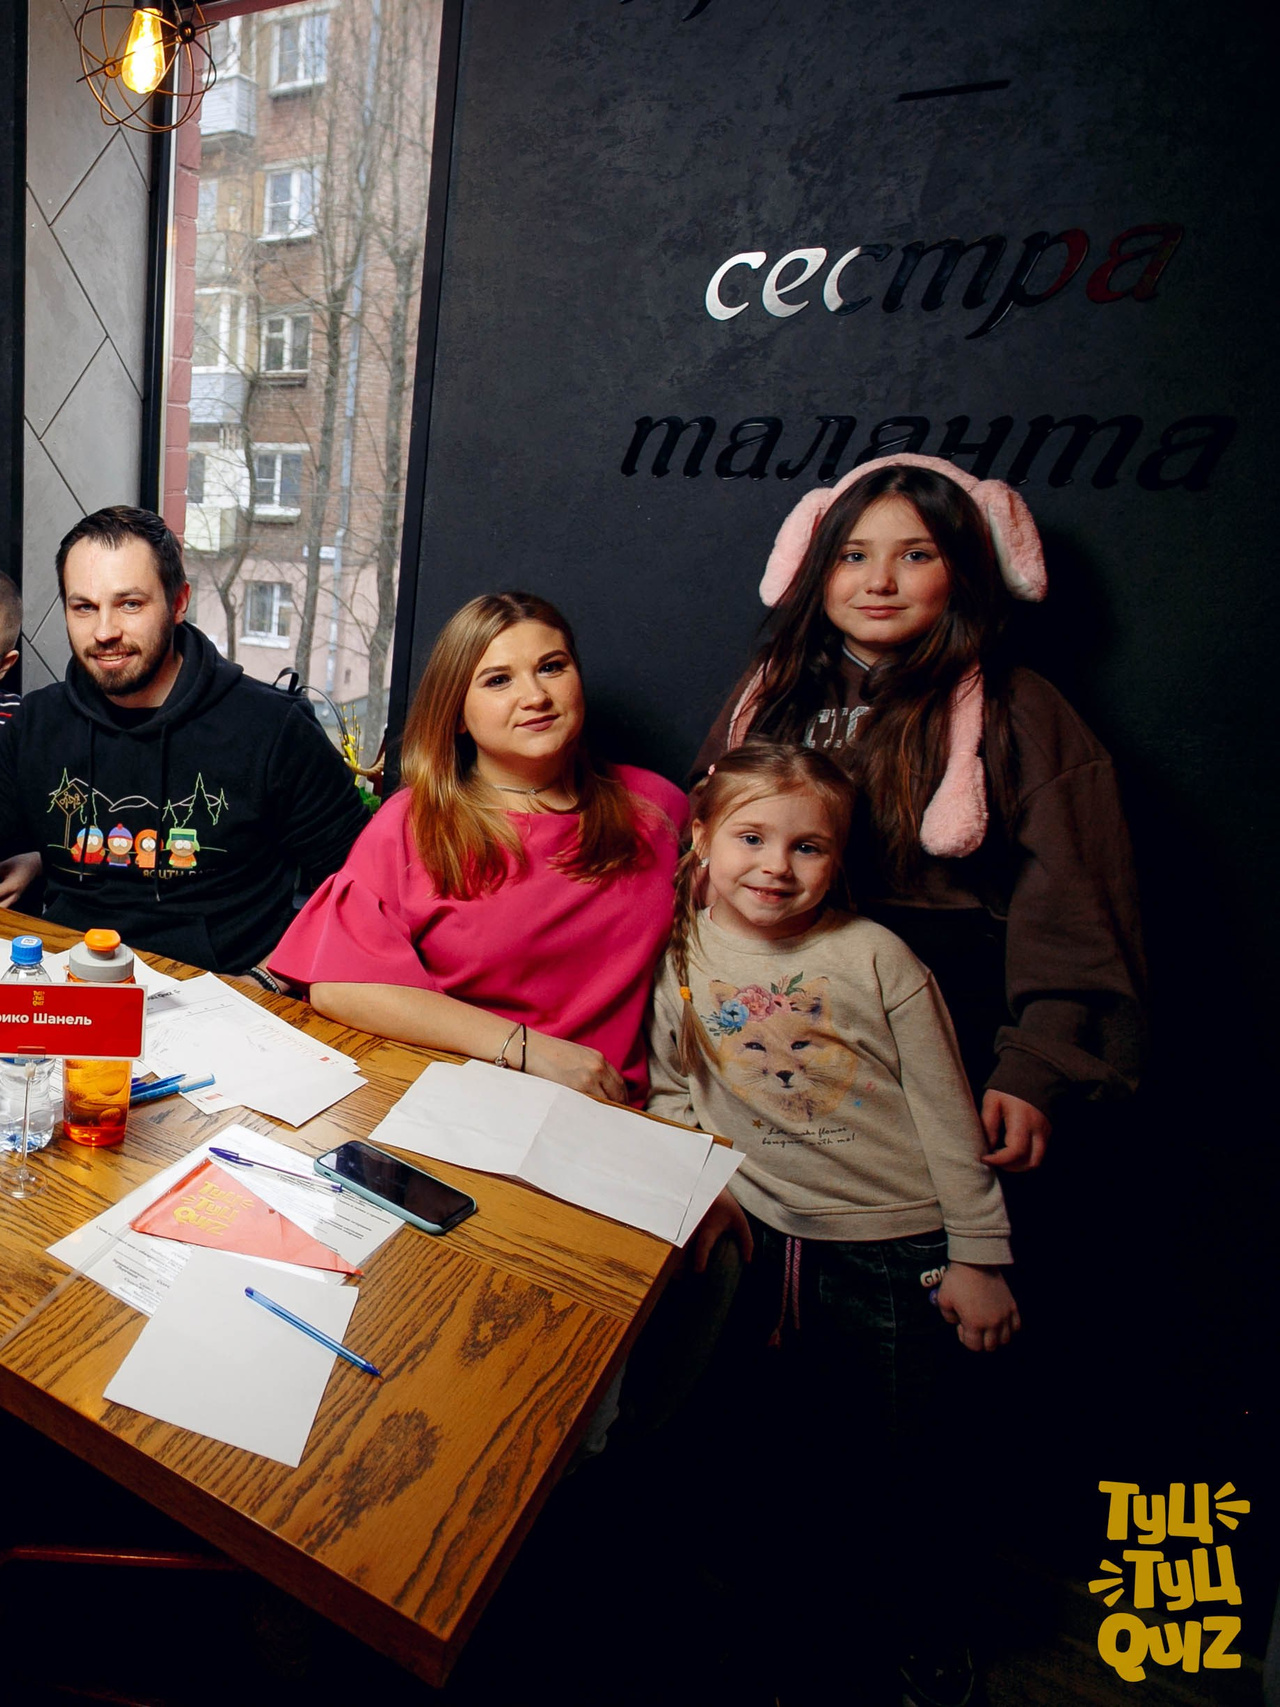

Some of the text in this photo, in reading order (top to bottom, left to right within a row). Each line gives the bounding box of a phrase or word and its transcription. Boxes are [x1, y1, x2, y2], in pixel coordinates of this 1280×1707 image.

[704, 222, 1185, 341] сестра
[620, 413, 1239, 493] таланта
[32, 1012, 92, 1026] Шанель
